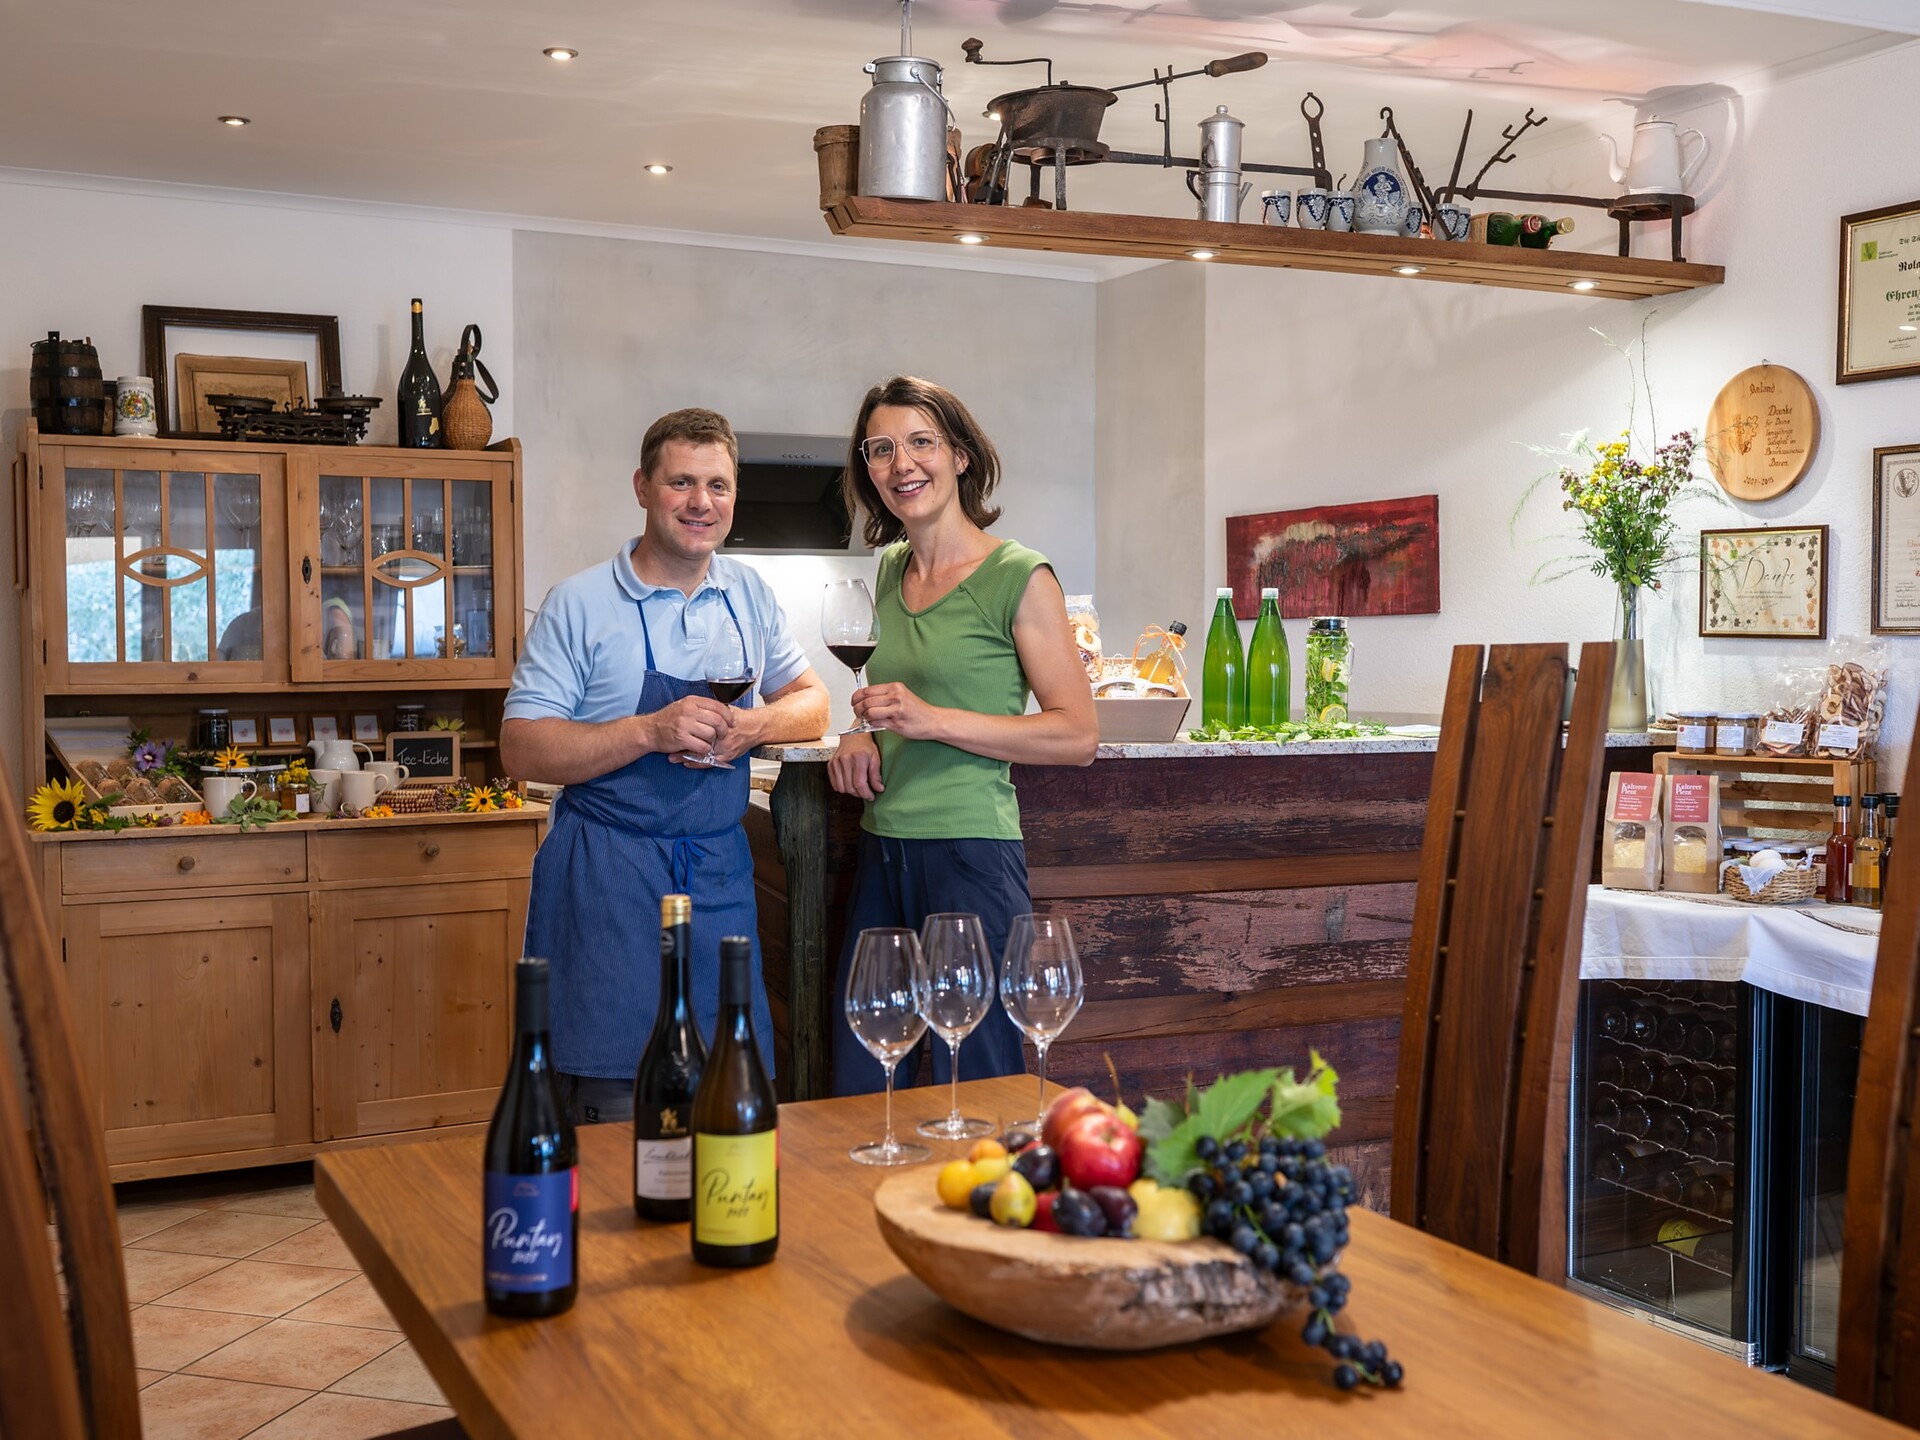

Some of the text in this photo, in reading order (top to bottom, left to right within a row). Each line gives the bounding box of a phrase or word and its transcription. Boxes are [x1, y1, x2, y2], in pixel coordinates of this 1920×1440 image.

[1768, 404, 1793, 416] Danke
[1741, 556, 1795, 591] Danke
[397, 747, 449, 765] Tee-Ecke
[1622, 782, 1648, 791] Kalterer
[1675, 782, 1702, 791] Kalterer
